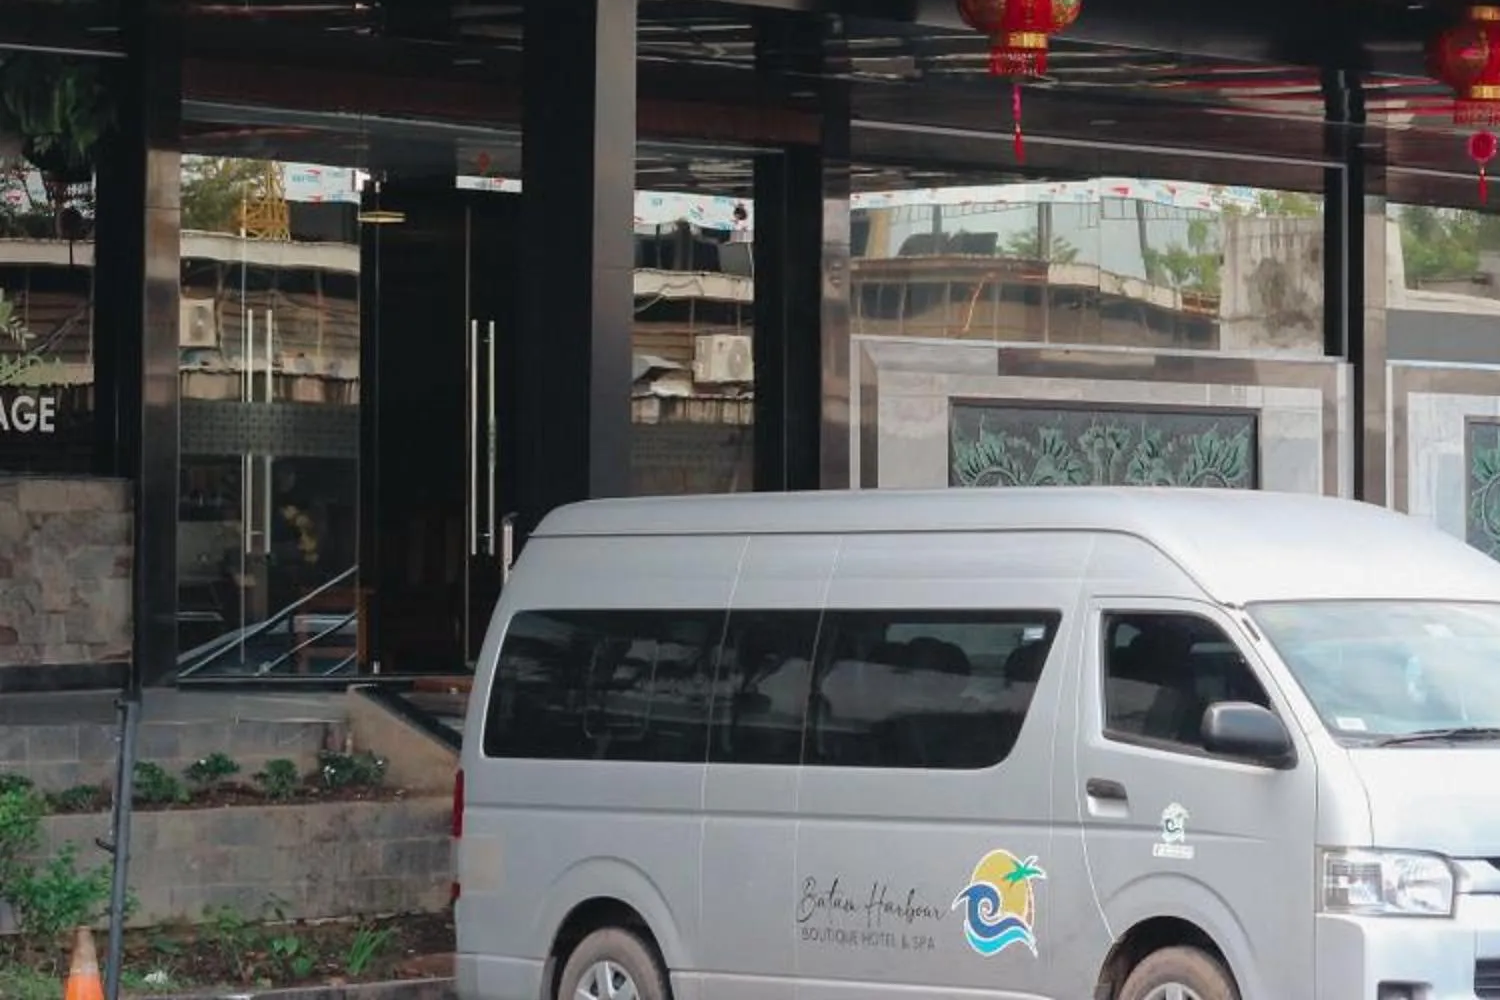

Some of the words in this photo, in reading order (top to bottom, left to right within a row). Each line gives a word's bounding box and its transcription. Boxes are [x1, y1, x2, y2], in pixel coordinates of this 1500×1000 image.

[797, 876, 857, 923] Batam
[864, 881, 948, 928] Harbour
[801, 926, 858, 946] BOUTIQUE
[861, 930, 896, 947] HOTEL
[911, 936, 936, 951] SPA
